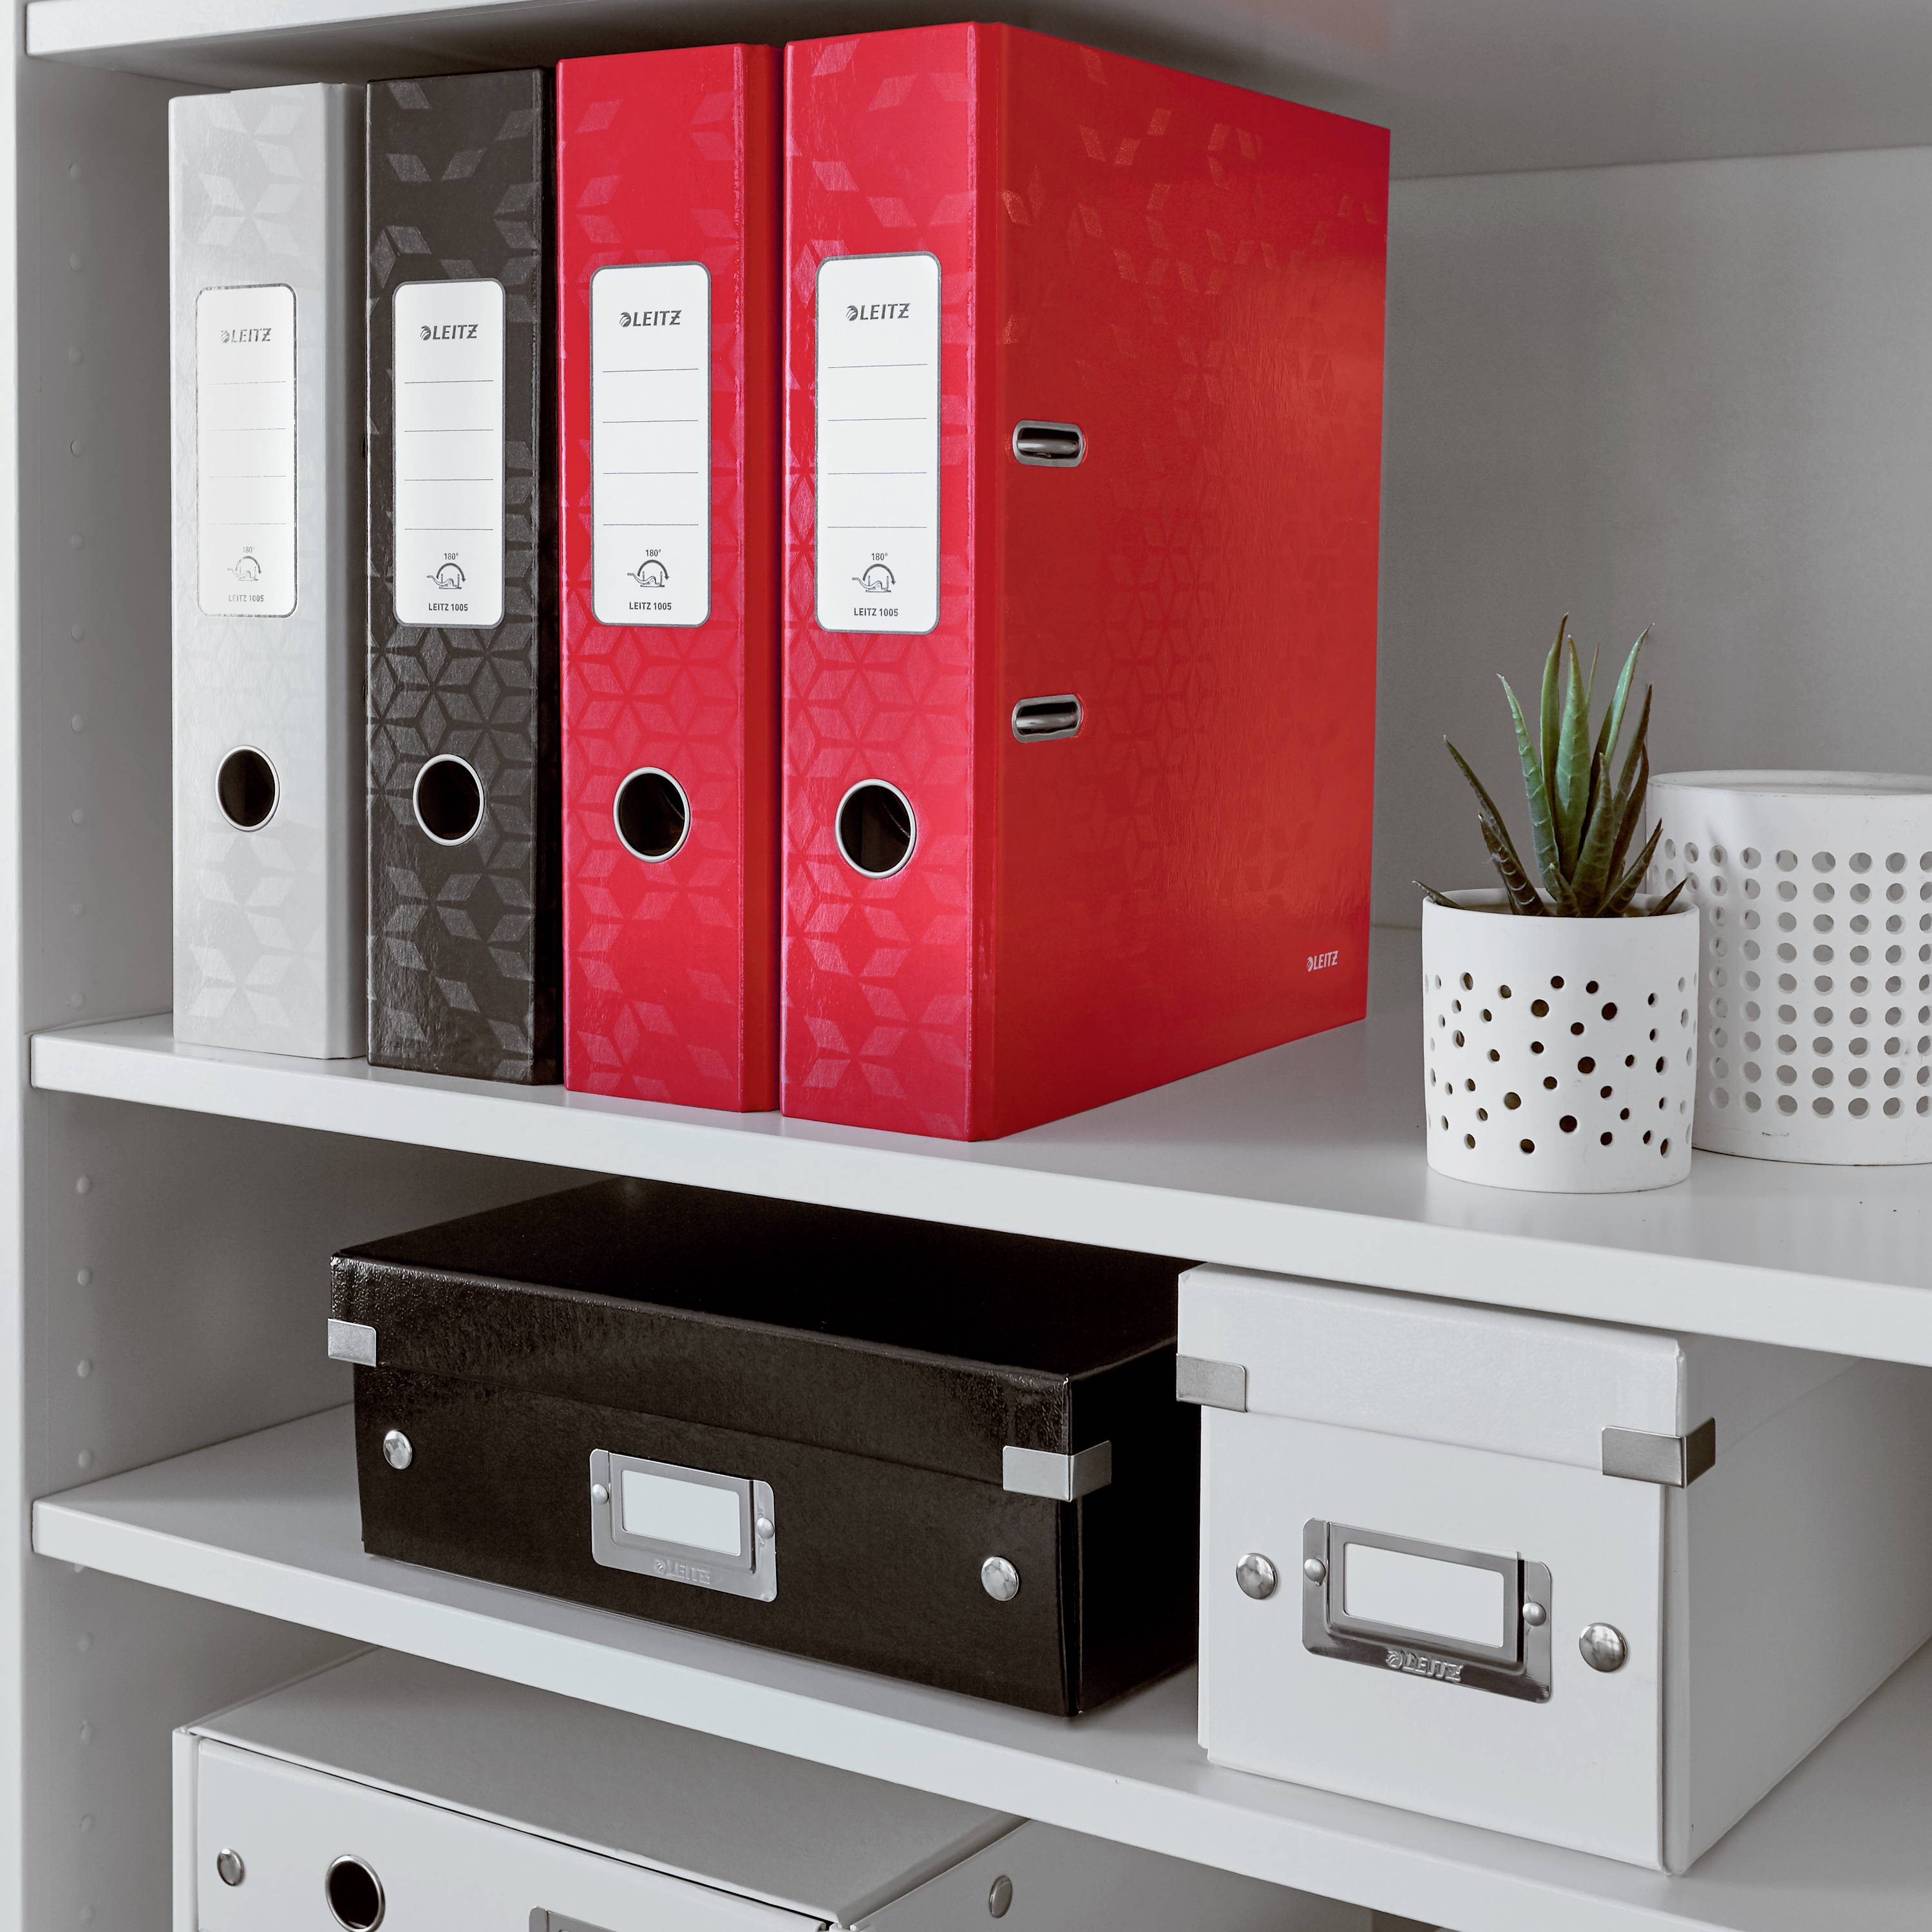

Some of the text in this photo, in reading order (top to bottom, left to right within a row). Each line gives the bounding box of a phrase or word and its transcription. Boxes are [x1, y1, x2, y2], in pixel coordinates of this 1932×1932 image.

[859, 302, 911, 321] LEITZ
[632, 309, 683, 327] LEITZ
[231, 327, 272, 343] LEITZ
[431, 323, 479, 341] LEITZ
[242, 545, 256, 554] 180
[645, 548, 662, 557] 180°
[871, 552, 889, 561] 180°
[228, 594, 265, 603] LEITZ 1005
[428, 602, 469, 612] LEITZ 1005
[629, 601, 672, 611] LEITZ 1005
[853, 607, 899, 617] LEITZ 1005
[1312, 949, 1340, 971] LEITZ
[1401, 1653, 1464, 1683] LEITZ
